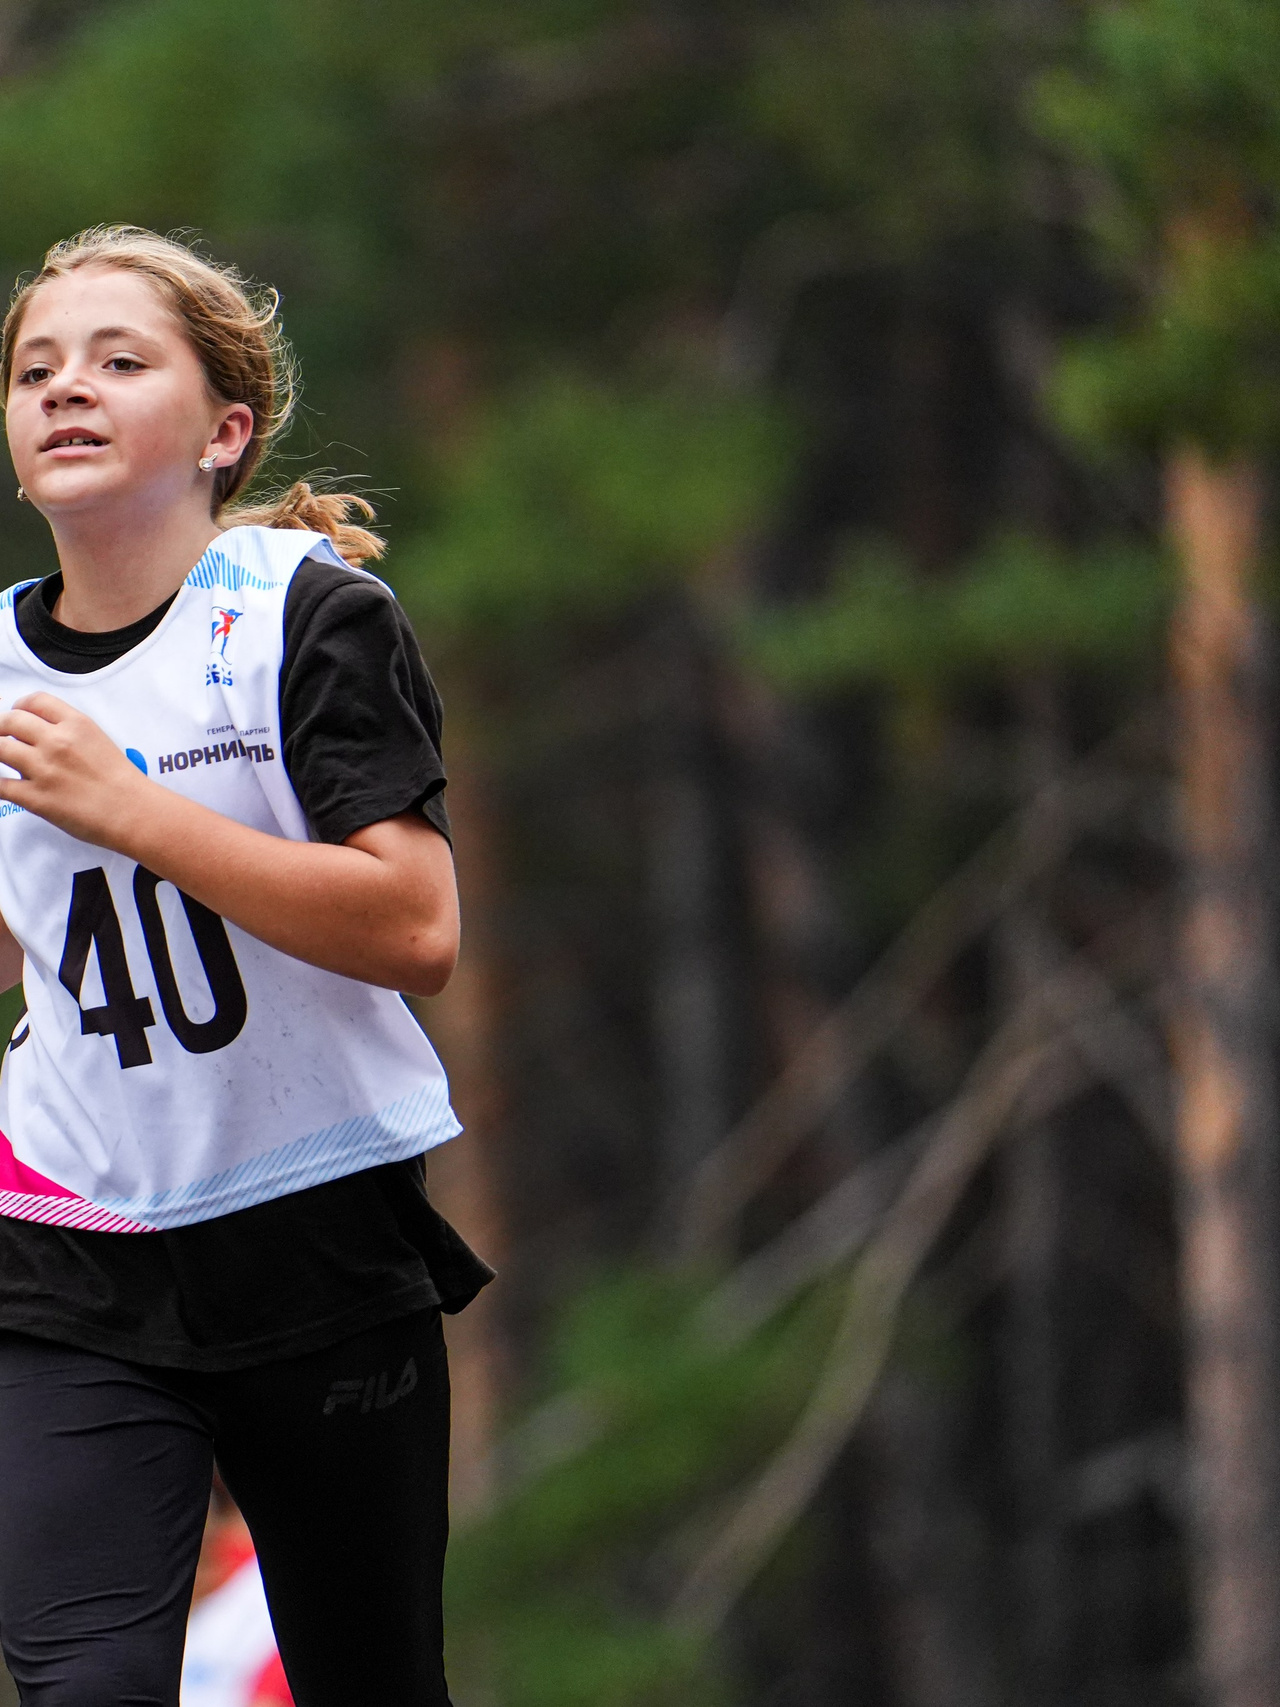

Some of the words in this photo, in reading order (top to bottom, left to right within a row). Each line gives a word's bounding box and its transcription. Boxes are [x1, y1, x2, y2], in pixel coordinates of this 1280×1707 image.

[207, 724, 236, 735] ГЕНЕРА
[158, 739, 275, 774] НОРНИЛЬ
[58, 863, 247, 1069] 40
[323, 1357, 419, 1415] FILA
